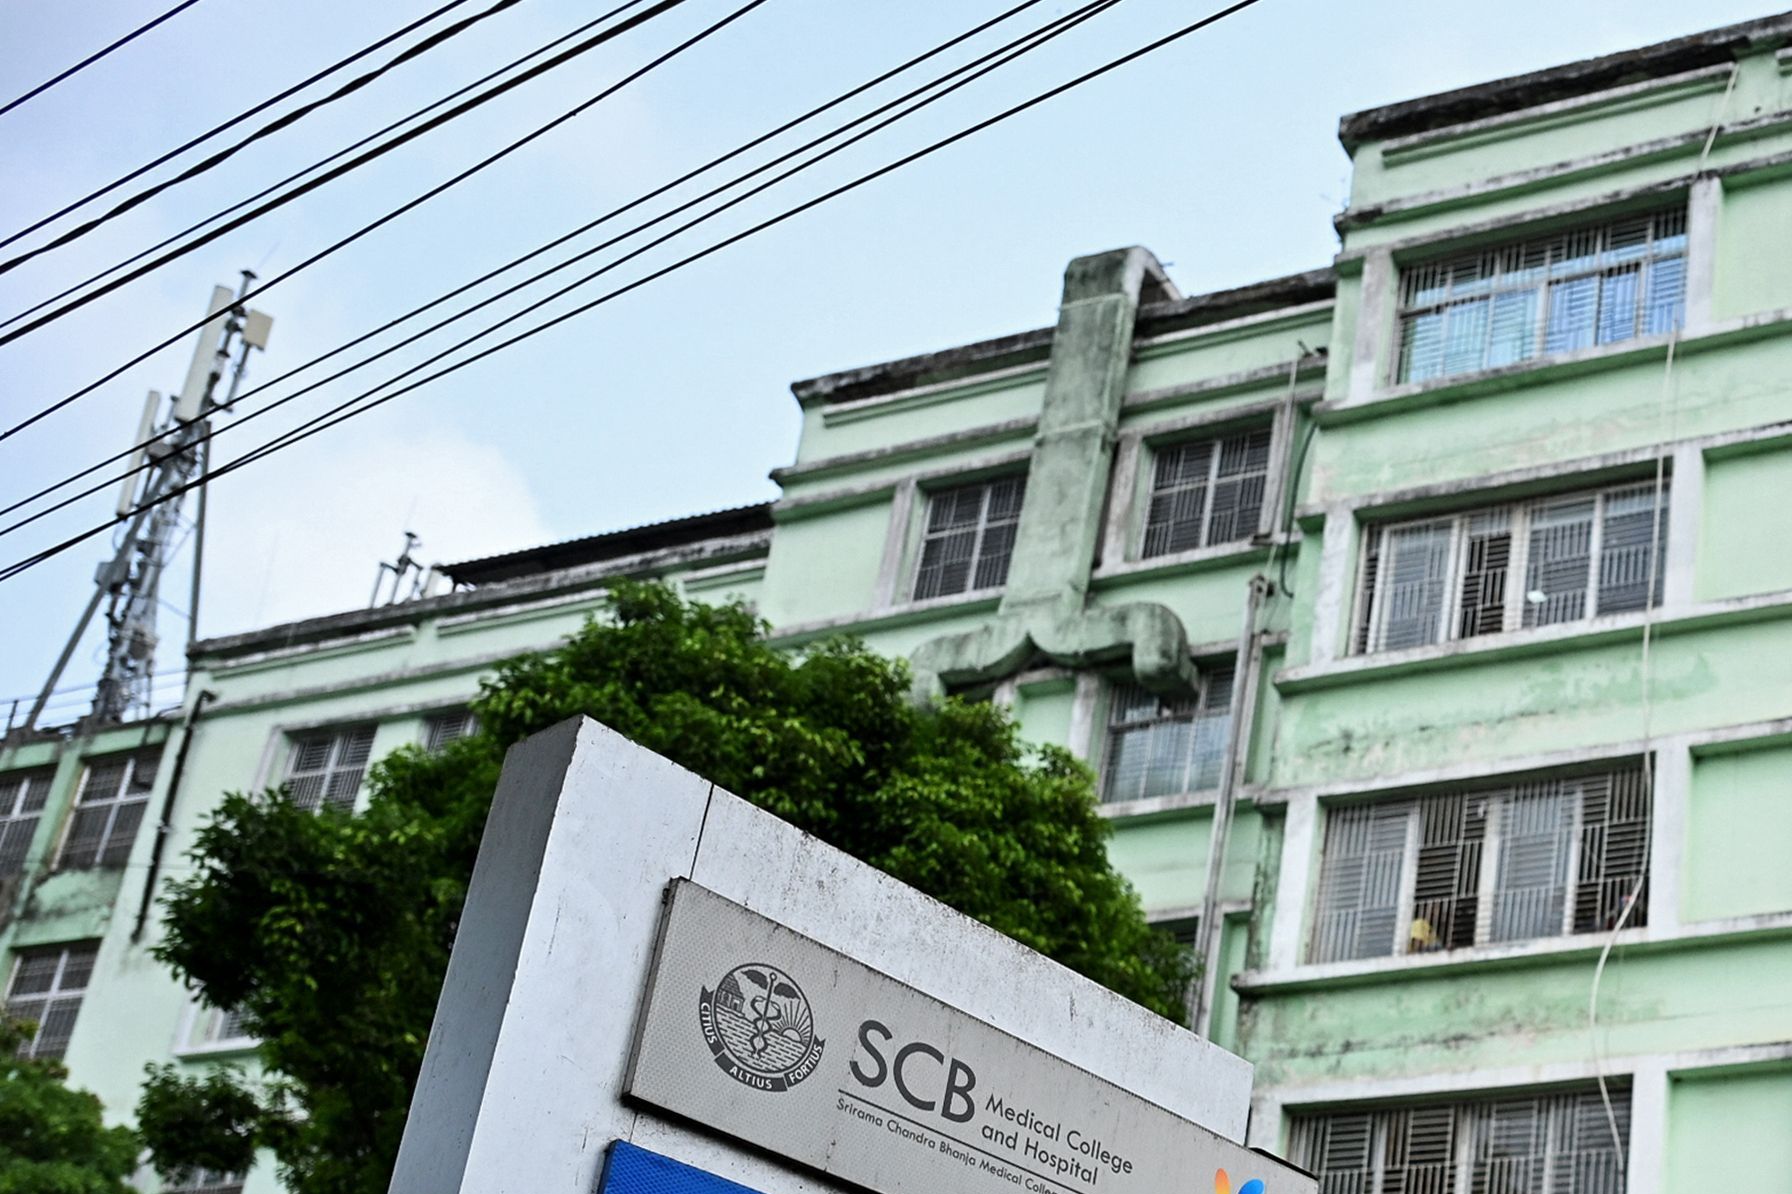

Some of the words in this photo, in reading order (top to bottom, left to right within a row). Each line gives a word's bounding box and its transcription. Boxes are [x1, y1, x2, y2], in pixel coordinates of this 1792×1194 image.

[701, 1002, 718, 1044] CITIUS
[730, 1066, 772, 1089] ALTIUS
[789, 1044, 823, 1084] FORTIUS
[850, 1019, 976, 1123] SCB
[836, 1097, 883, 1127] Srirama
[887, 1119, 936, 1150] Chandra
[939, 1140, 977, 1167] Bhanja
[979, 1159, 1022, 1186] Medical
[981, 1124, 1019, 1151] and
[1024, 1138, 1098, 1185] Hospital
[985, 1093, 1061, 1142] Medical
[1067, 1130, 1133, 1177] College
